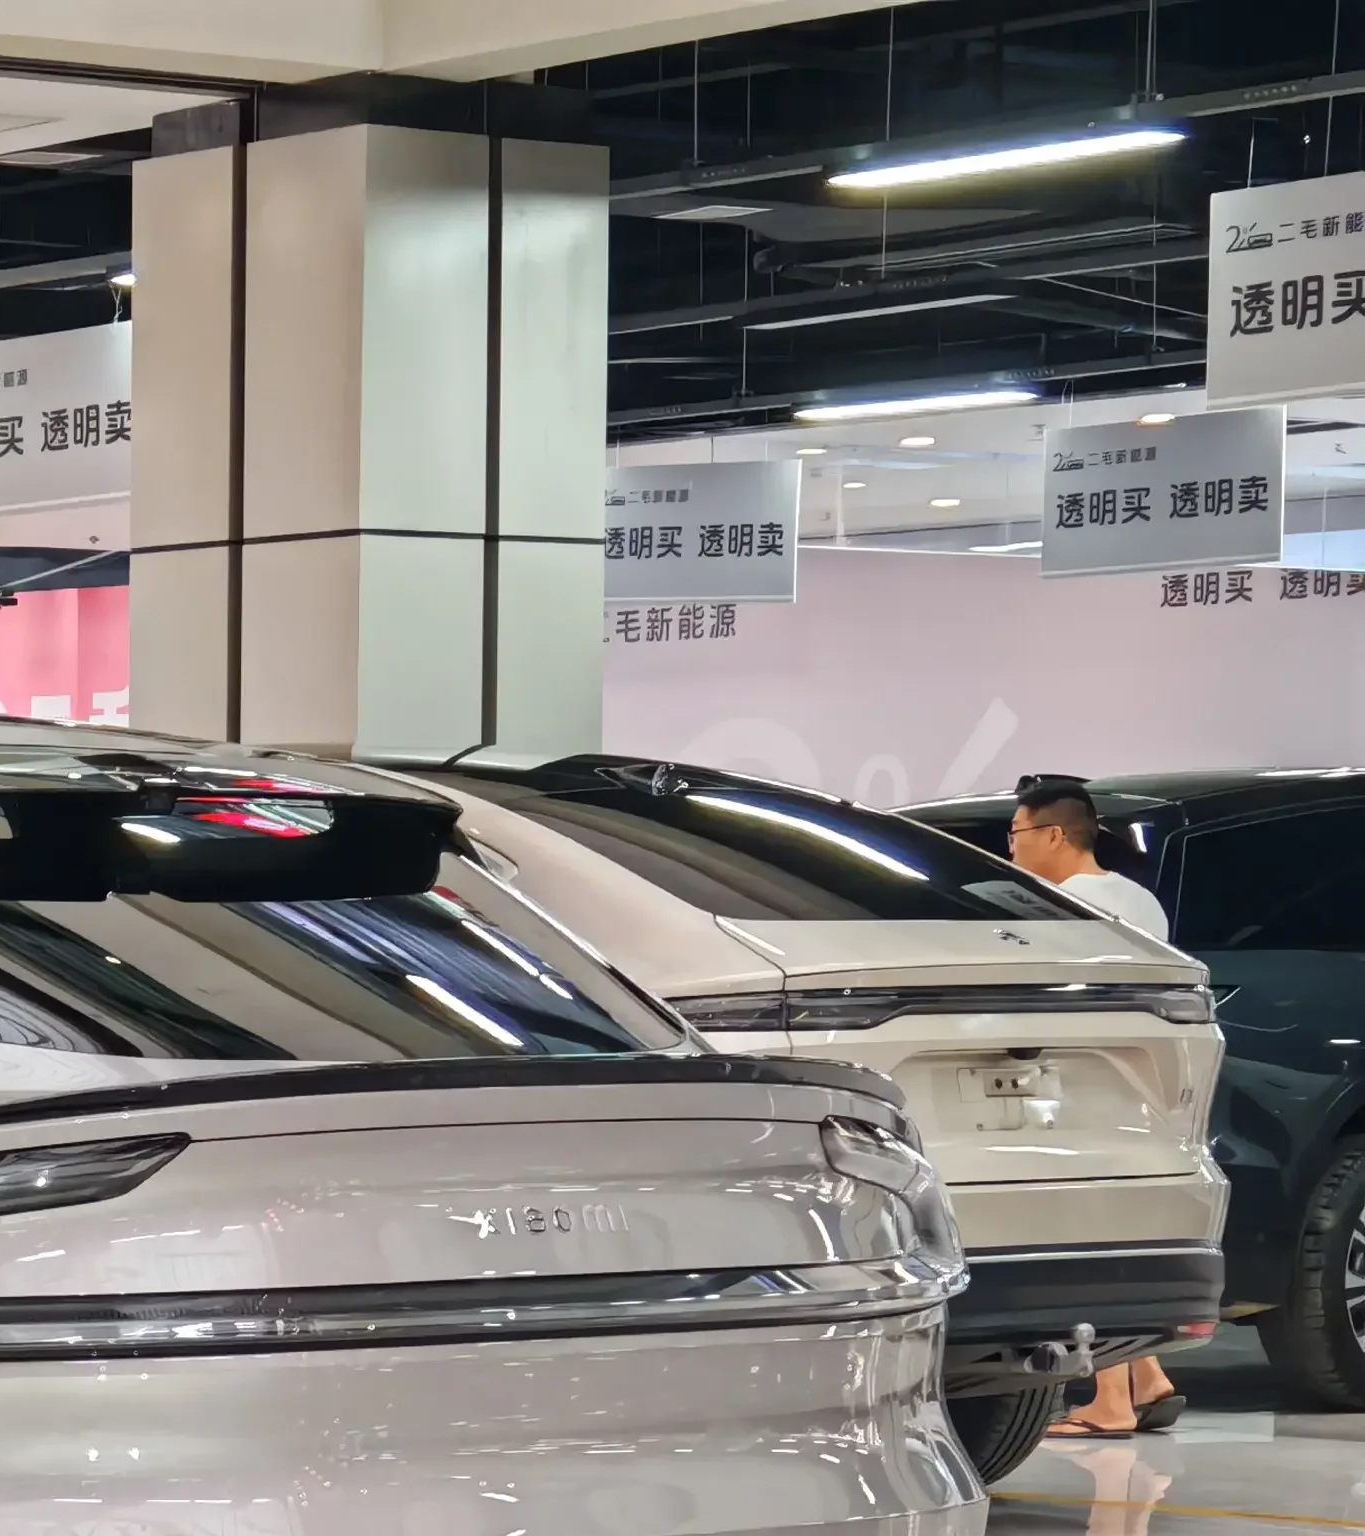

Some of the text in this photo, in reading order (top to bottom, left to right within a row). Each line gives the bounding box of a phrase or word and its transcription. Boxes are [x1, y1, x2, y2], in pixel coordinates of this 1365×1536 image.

[1230, 269, 1365, 338] 透明买
[41, 400, 131, 452] 透明卖
[1056, 475, 1269, 529] 透明买 透明卖
[698, 522, 784, 558] 透明卖
[1160, 569, 1253, 608] 透明买
[603, 603, 737, 643] 毛新能源
